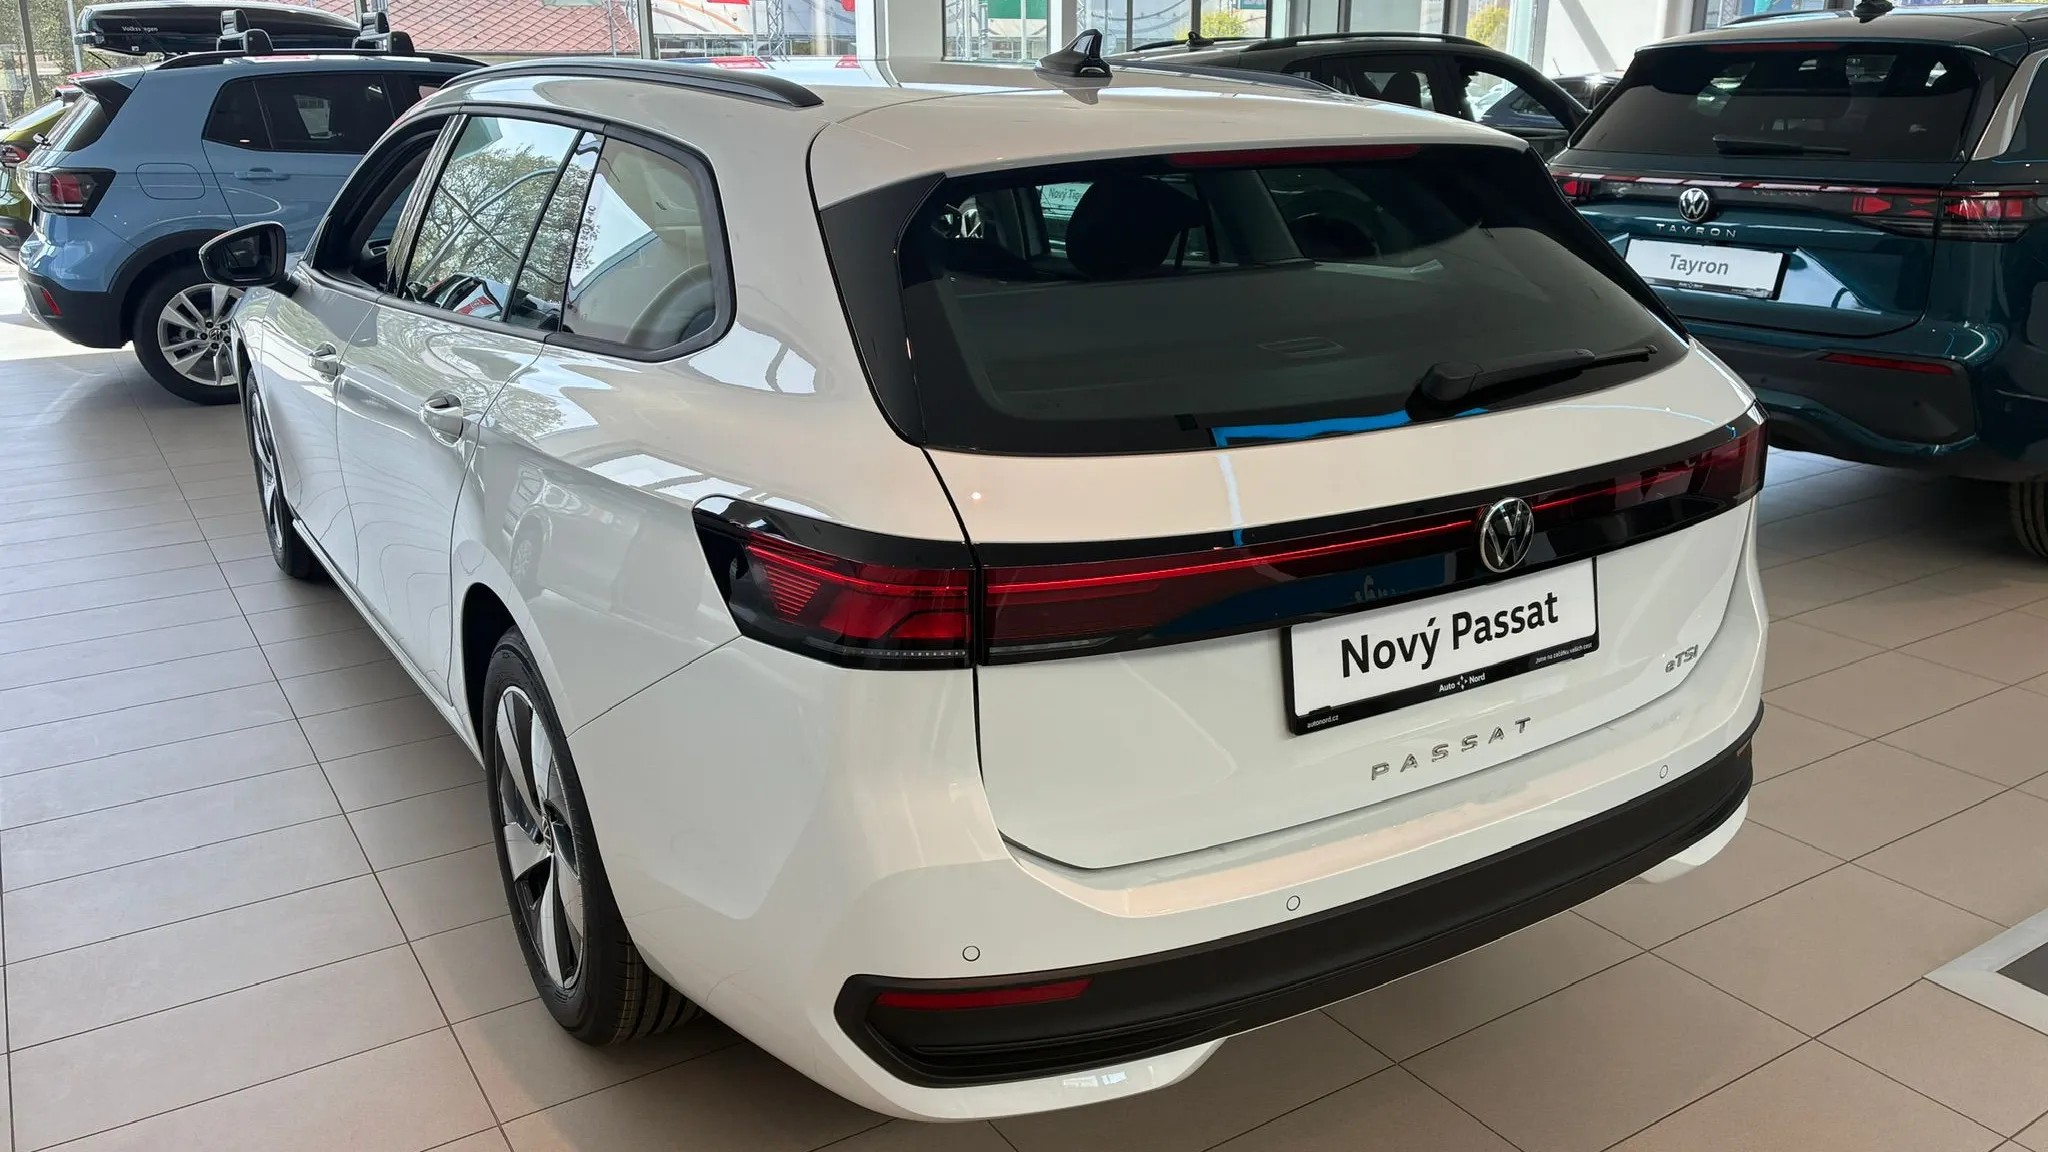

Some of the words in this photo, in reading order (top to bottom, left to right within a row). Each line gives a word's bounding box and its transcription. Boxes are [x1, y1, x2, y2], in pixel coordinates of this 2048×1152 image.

[1656, 223, 1737, 238] TAYRON
[1669, 253, 1729, 276] Tayron
[1341, 616, 1441, 679] Nový
[1452, 592, 1558, 650] Passat
[1665, 644, 1699, 673] eTSI
[1438, 682, 1456, 693] Auto
[1469, 672, 1486, 685] Nord
[1307, 714, 1339, 729] autonord.cz
[1371, 716, 1532, 781] PASSAT
